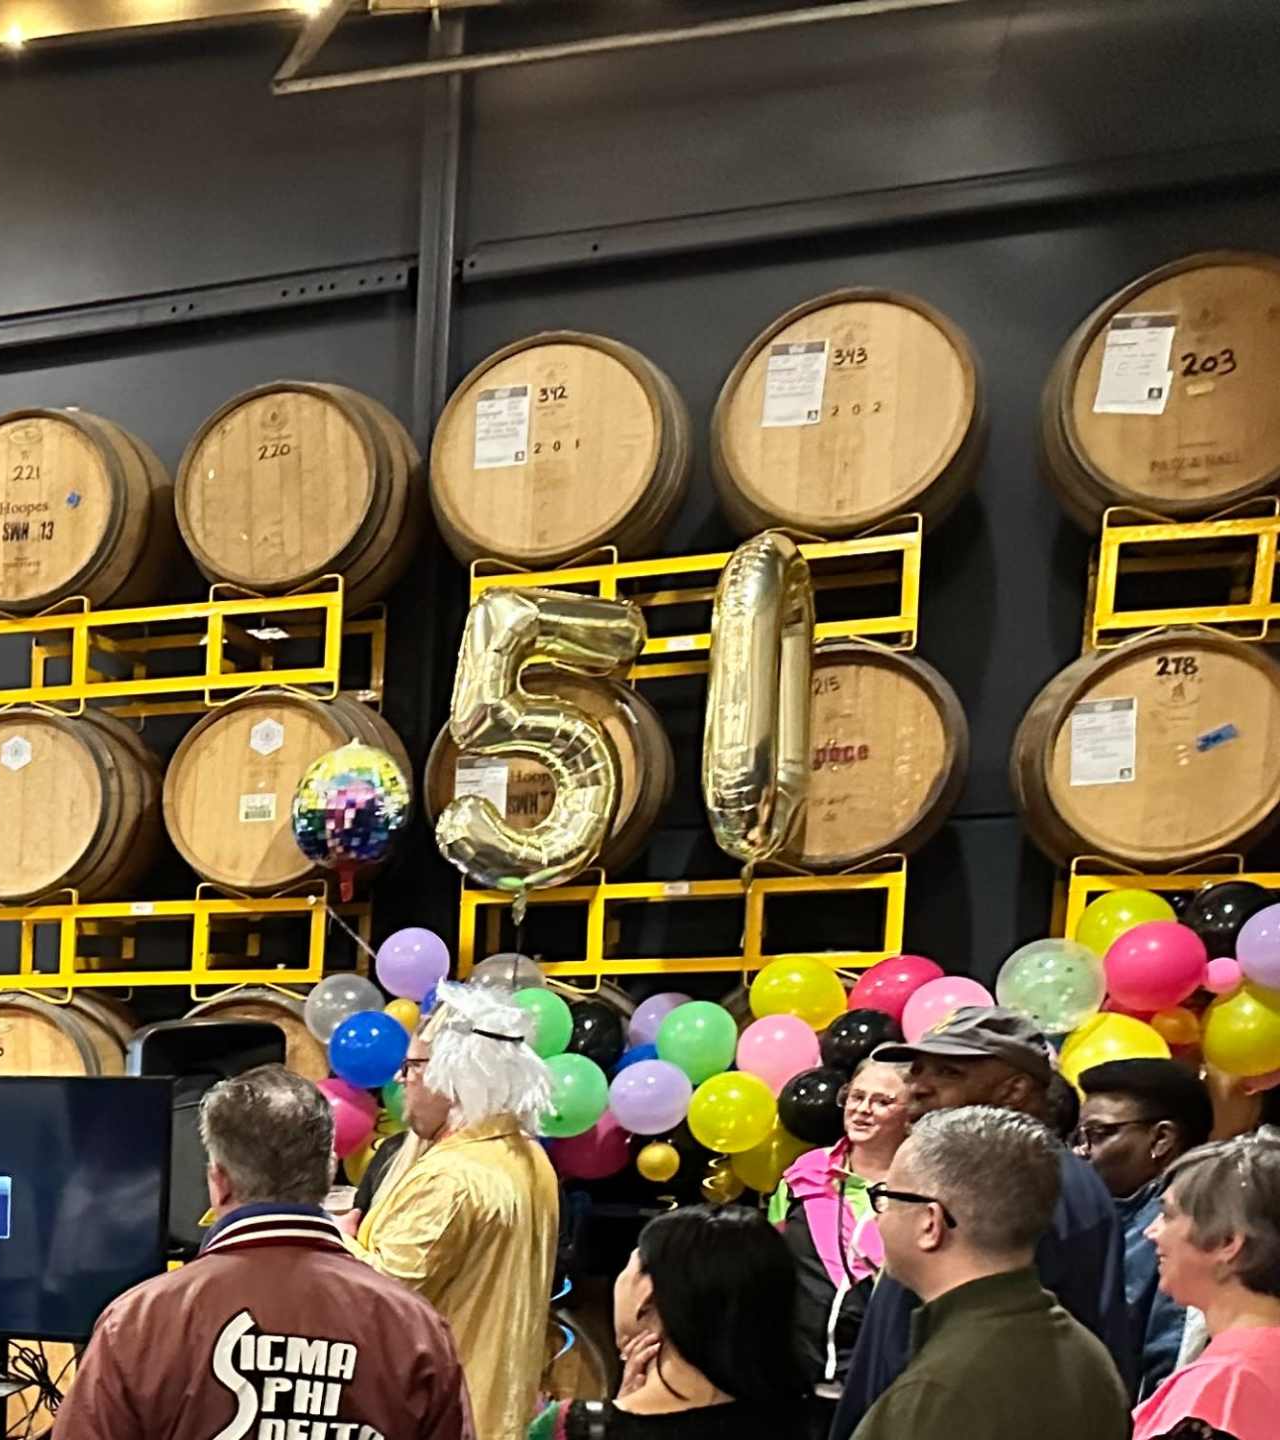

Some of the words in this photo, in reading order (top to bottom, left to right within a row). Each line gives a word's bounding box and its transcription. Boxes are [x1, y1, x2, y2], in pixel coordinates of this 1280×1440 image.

[833, 347, 868, 365] 343
[1181, 348, 1237, 377] 203
[538, 386, 568, 402] 342
[258, 443, 291, 461] 220
[12, 465, 41, 481] 221
[0, 501, 49, 516] Hoopes
[40, 521, 54, 540] 13
[1156, 656, 1199, 676] 278
[261, 1377, 342, 1416] PHI
